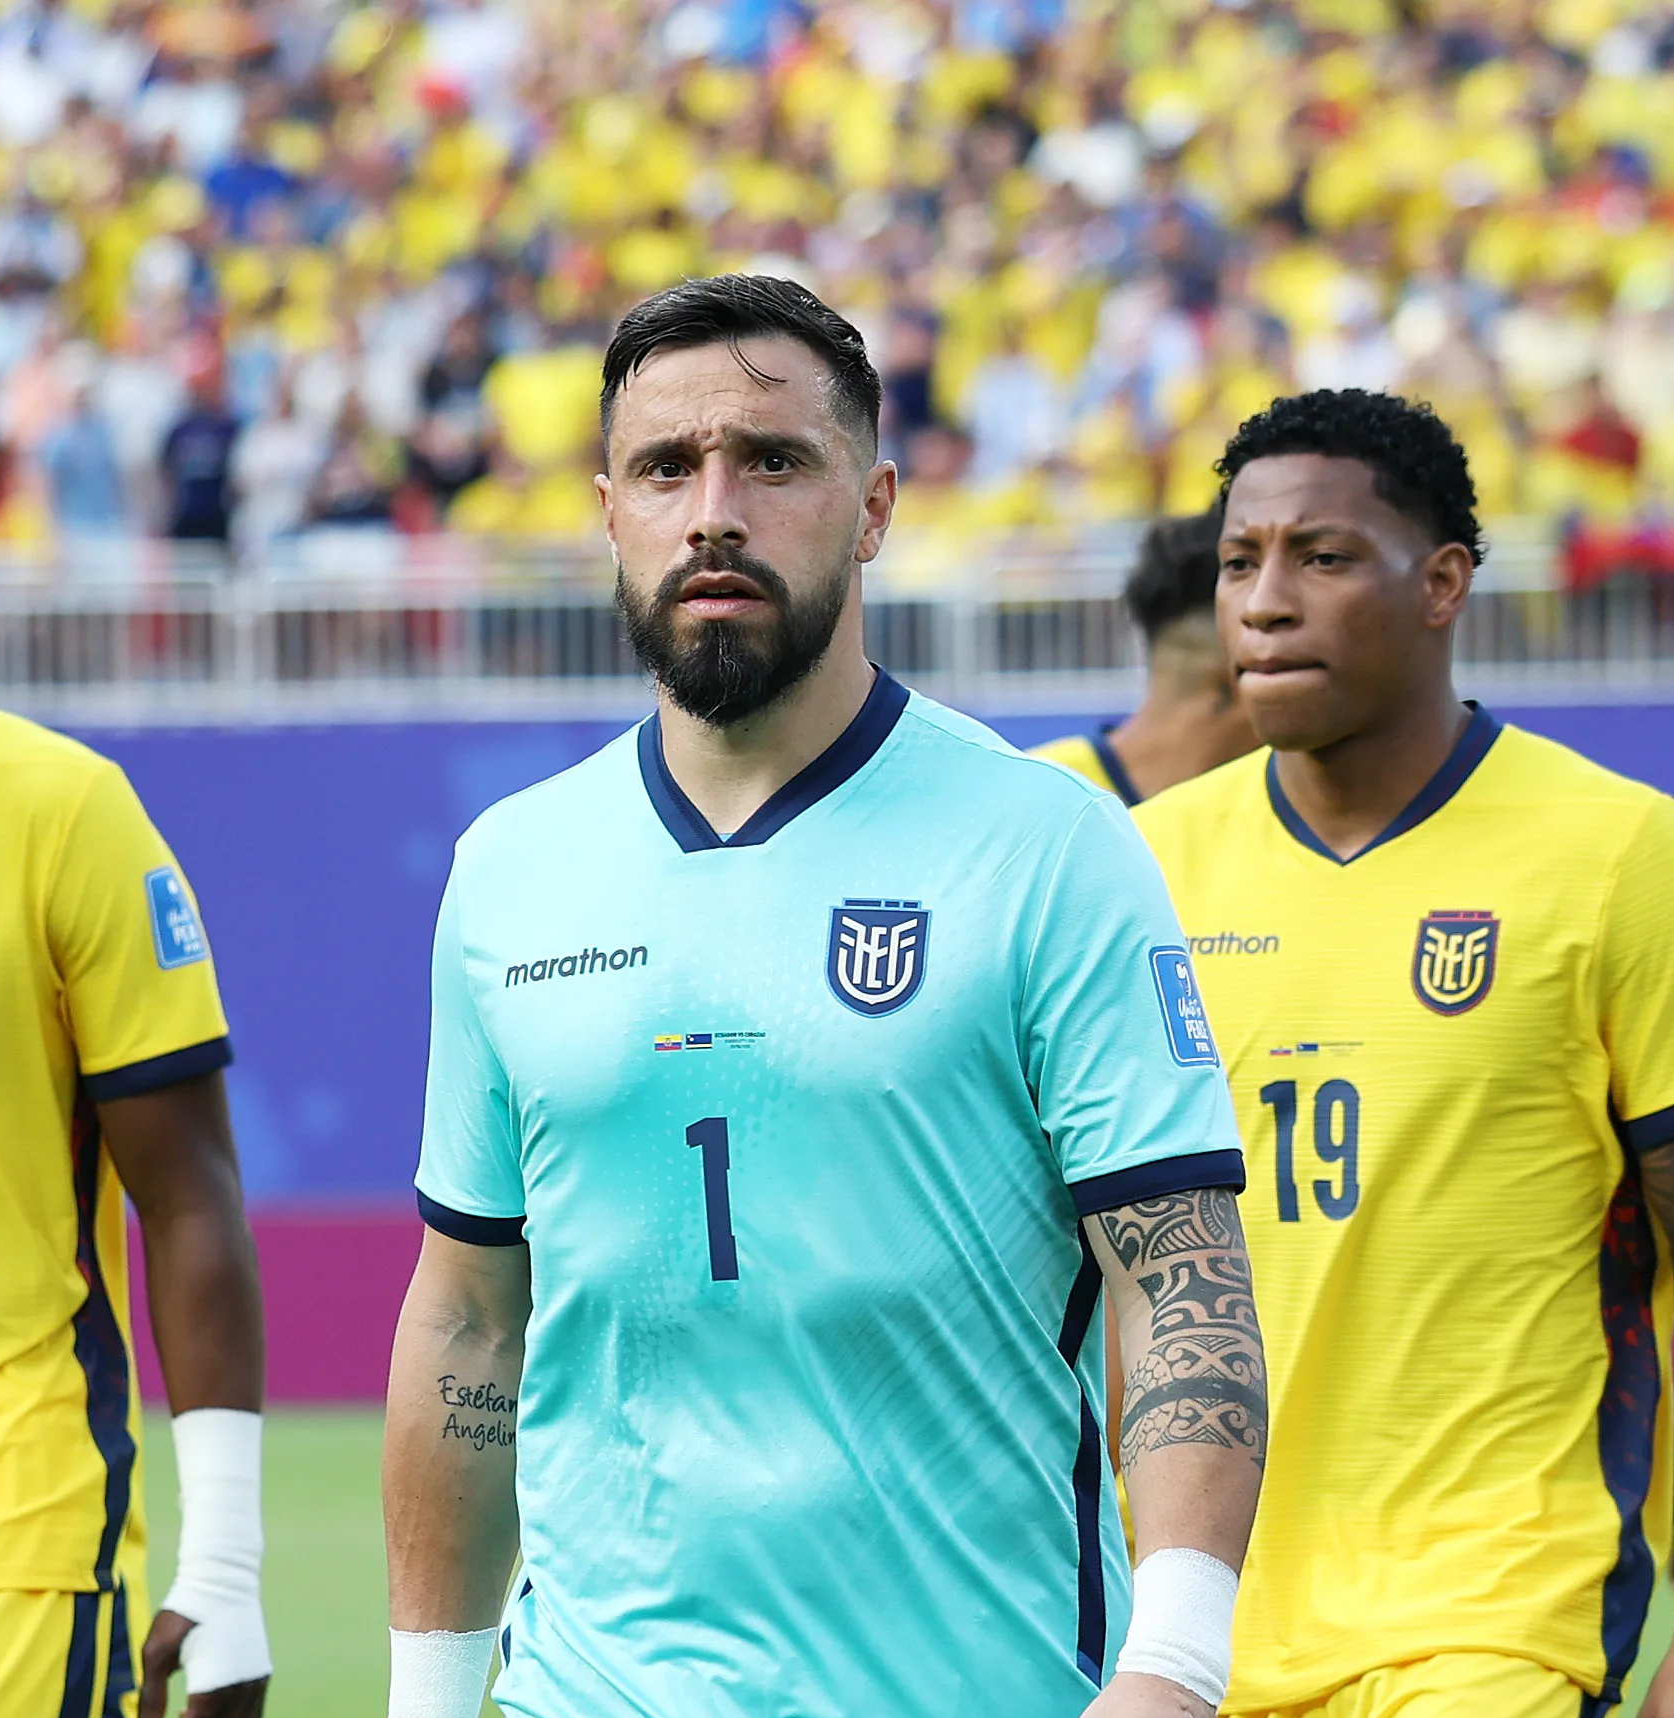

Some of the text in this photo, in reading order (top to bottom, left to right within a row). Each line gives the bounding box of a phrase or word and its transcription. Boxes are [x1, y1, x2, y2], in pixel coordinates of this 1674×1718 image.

[504, 945, 649, 988] marathon
[1185, 931, 1280, 956] rathon
[1259, 1078, 1361, 1222] 19
[685, 1116, 740, 1282] 1
